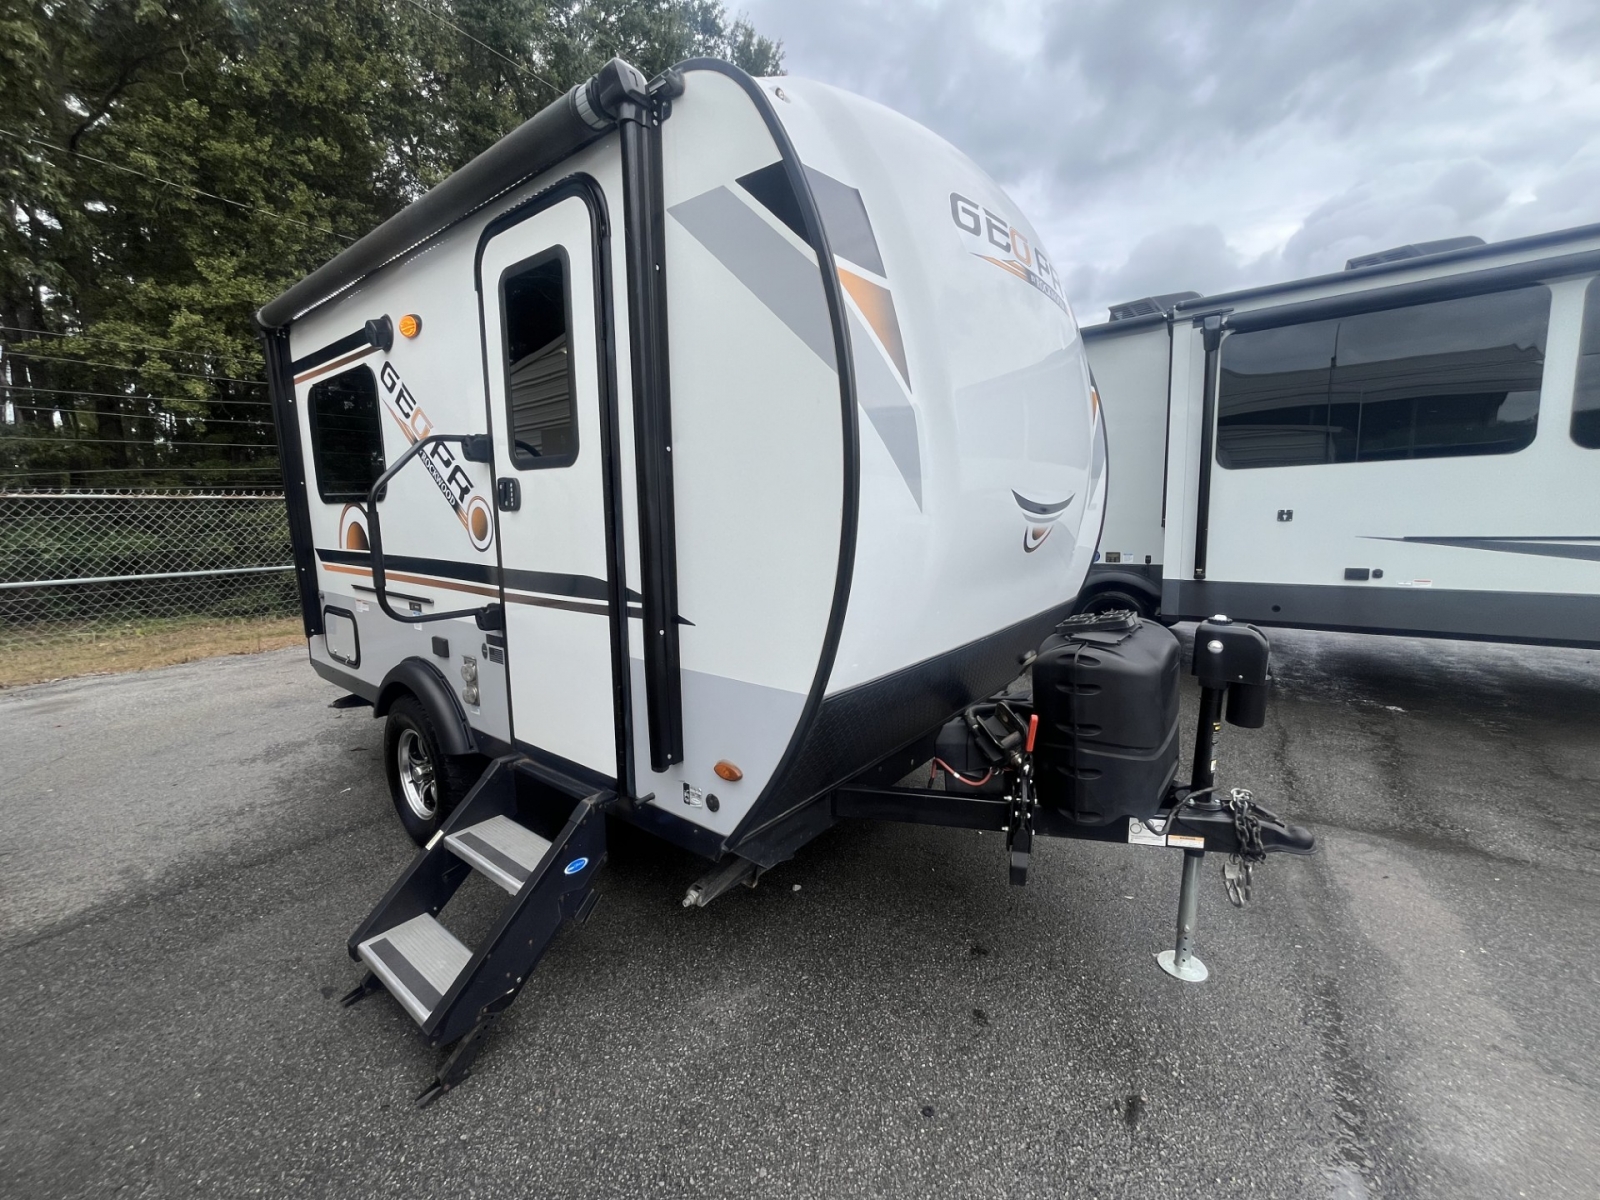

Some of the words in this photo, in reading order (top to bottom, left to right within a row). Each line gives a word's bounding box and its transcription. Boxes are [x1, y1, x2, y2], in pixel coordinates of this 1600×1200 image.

[949, 191, 1032, 268] GEO
[1034, 246, 1065, 300] PR
[380, 360, 434, 440] GEO
[420, 450, 457, 507] ROCKWOOD
